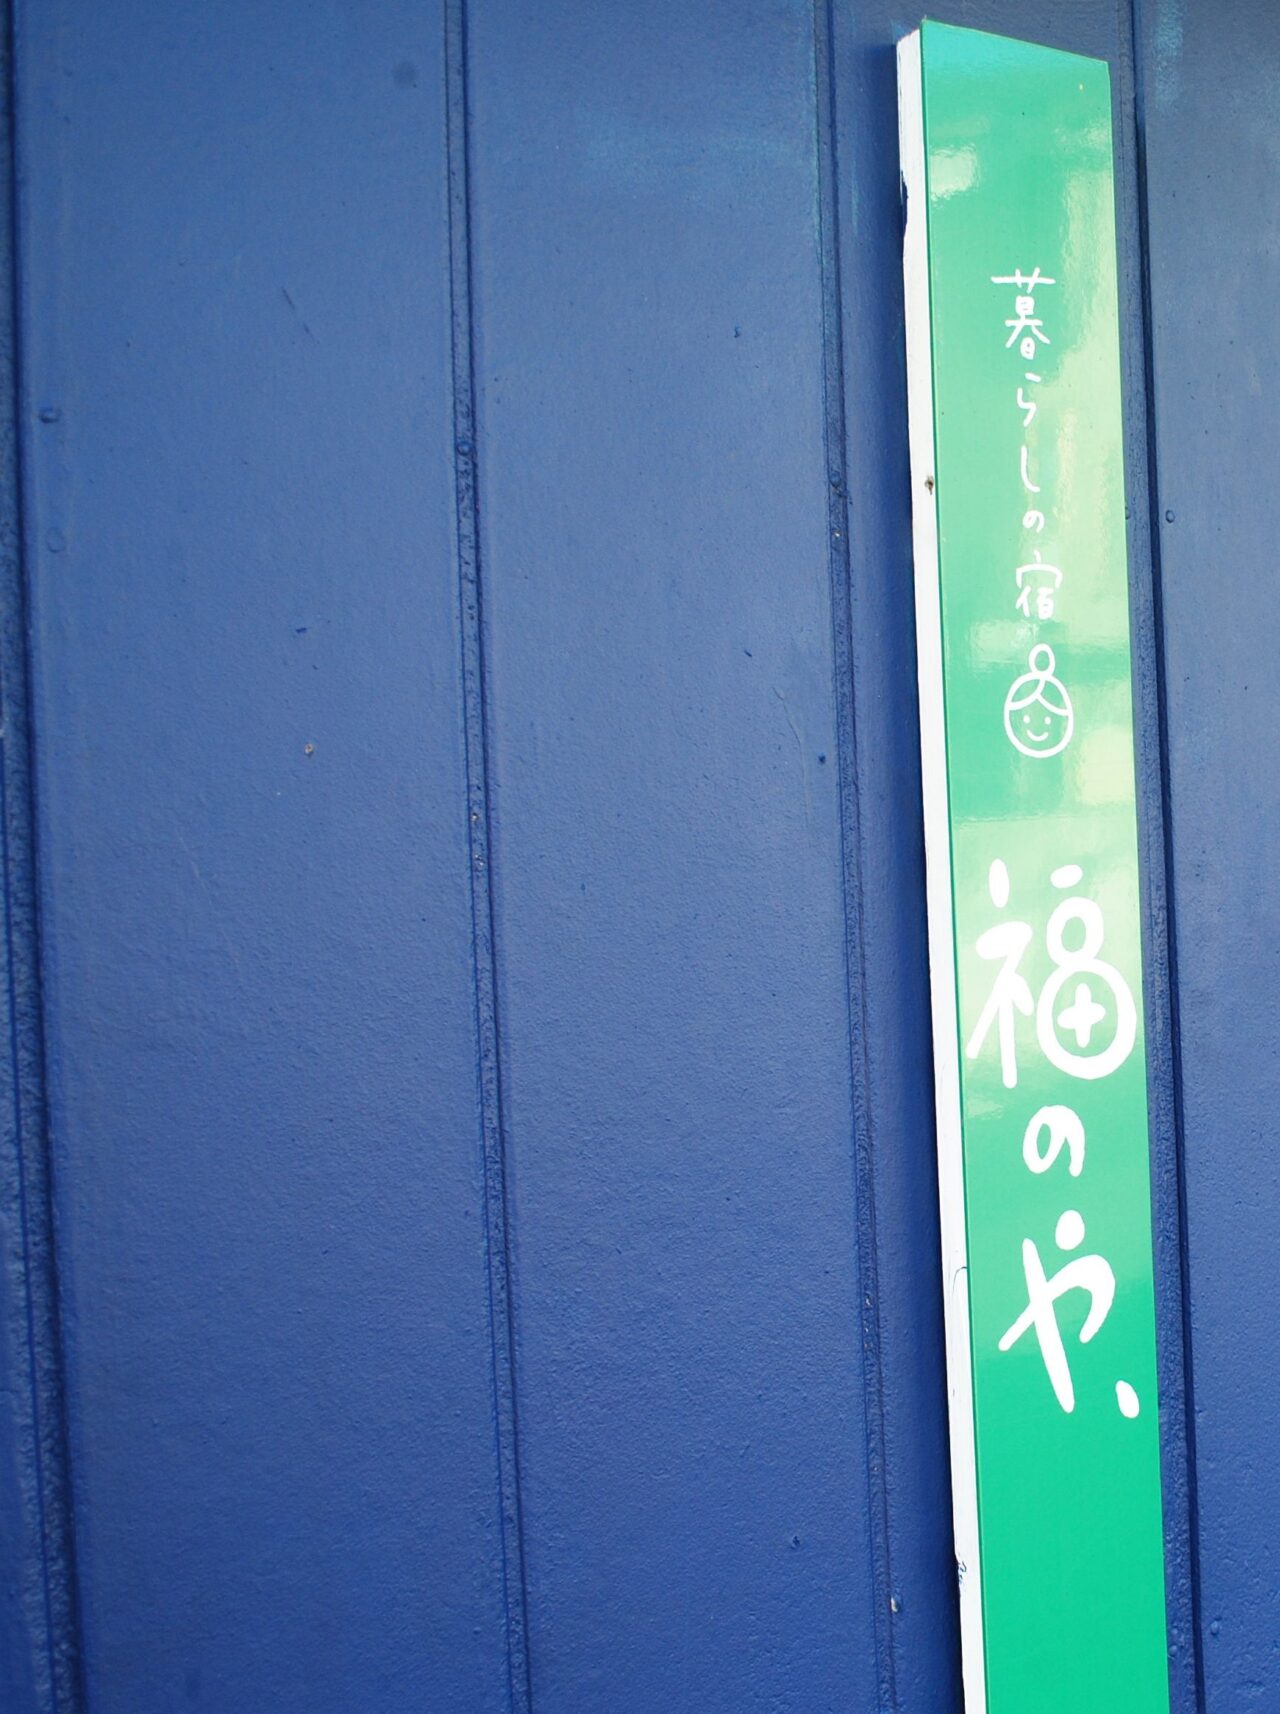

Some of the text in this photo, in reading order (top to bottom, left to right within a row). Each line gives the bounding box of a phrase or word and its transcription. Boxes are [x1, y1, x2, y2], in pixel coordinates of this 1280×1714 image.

[991, 267, 1062, 620] 暮らしの宿
